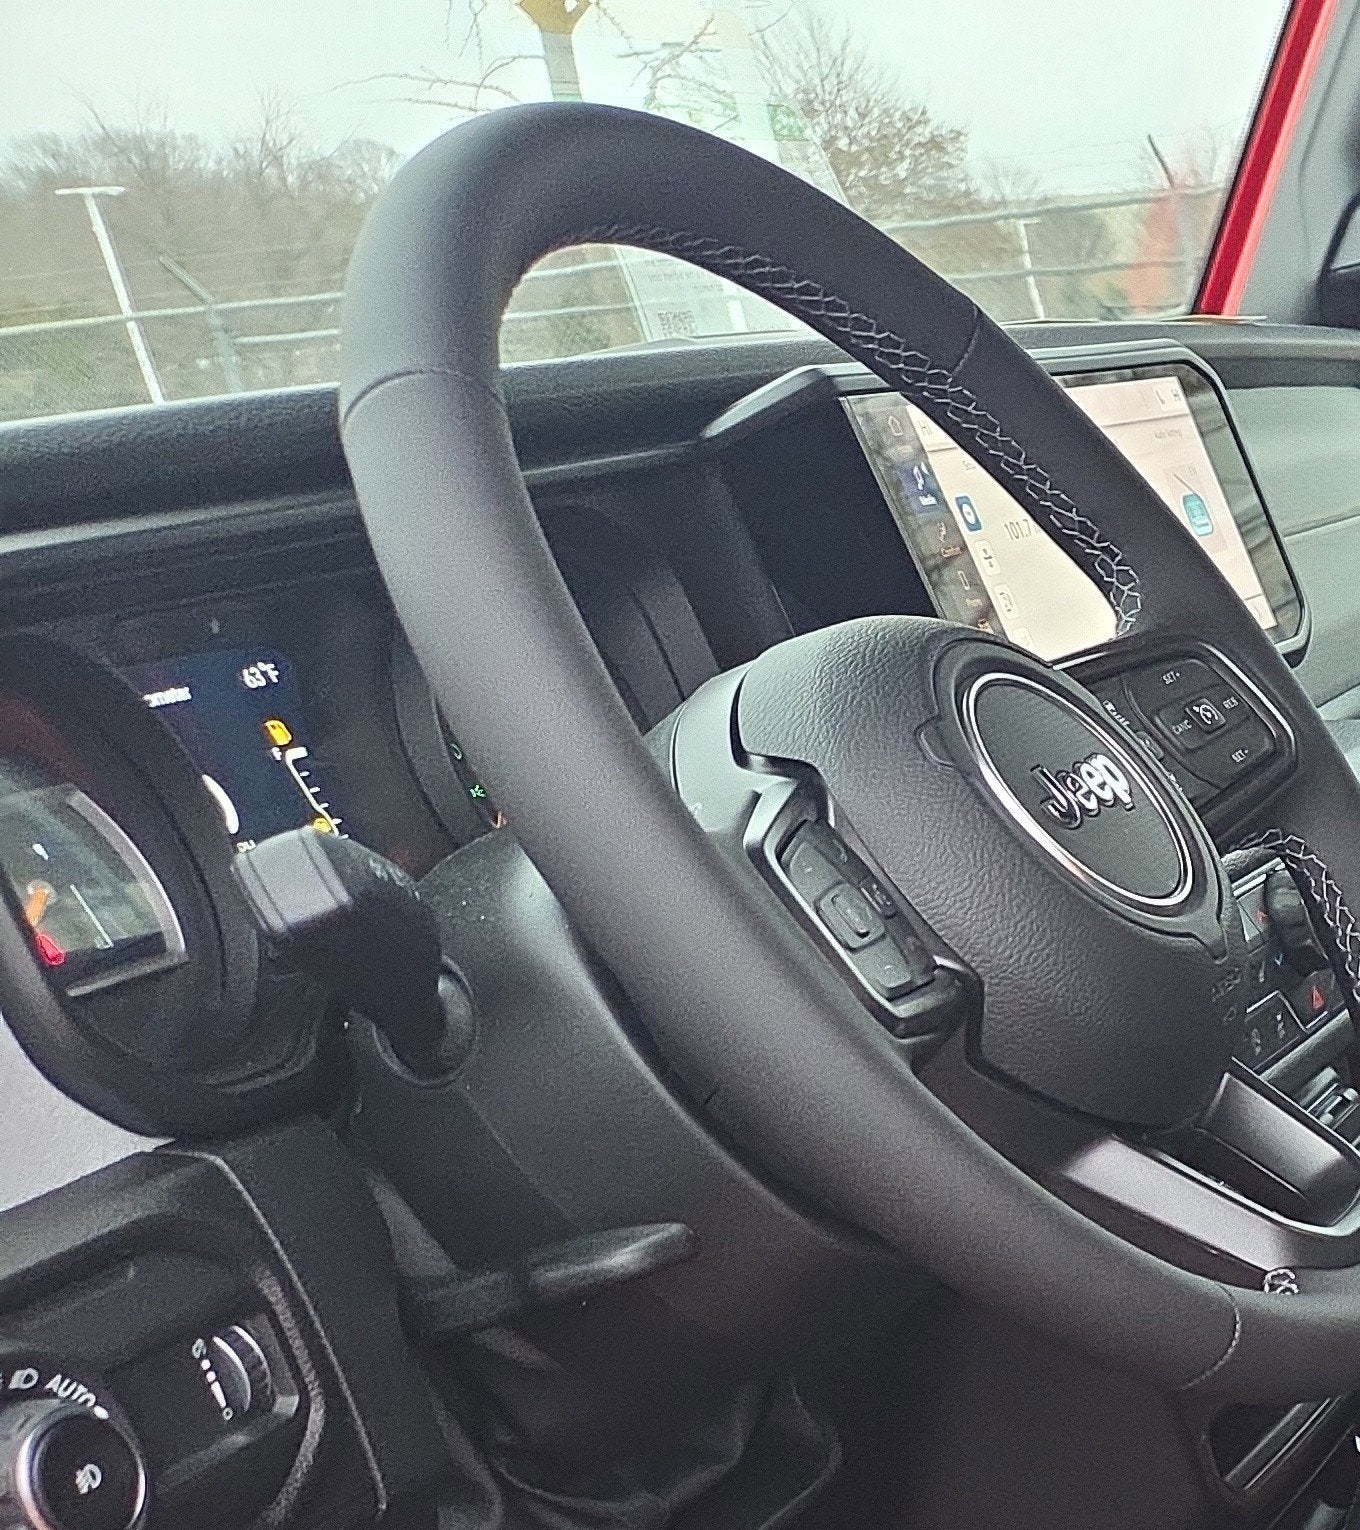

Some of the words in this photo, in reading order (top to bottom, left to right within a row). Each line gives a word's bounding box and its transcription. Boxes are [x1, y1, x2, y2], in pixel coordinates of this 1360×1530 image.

[1003, 518, 1033, 541] 101.7
[1031, 753, 1135, 829] Jeep
[44, 1374, 97, 1407] AUTO
